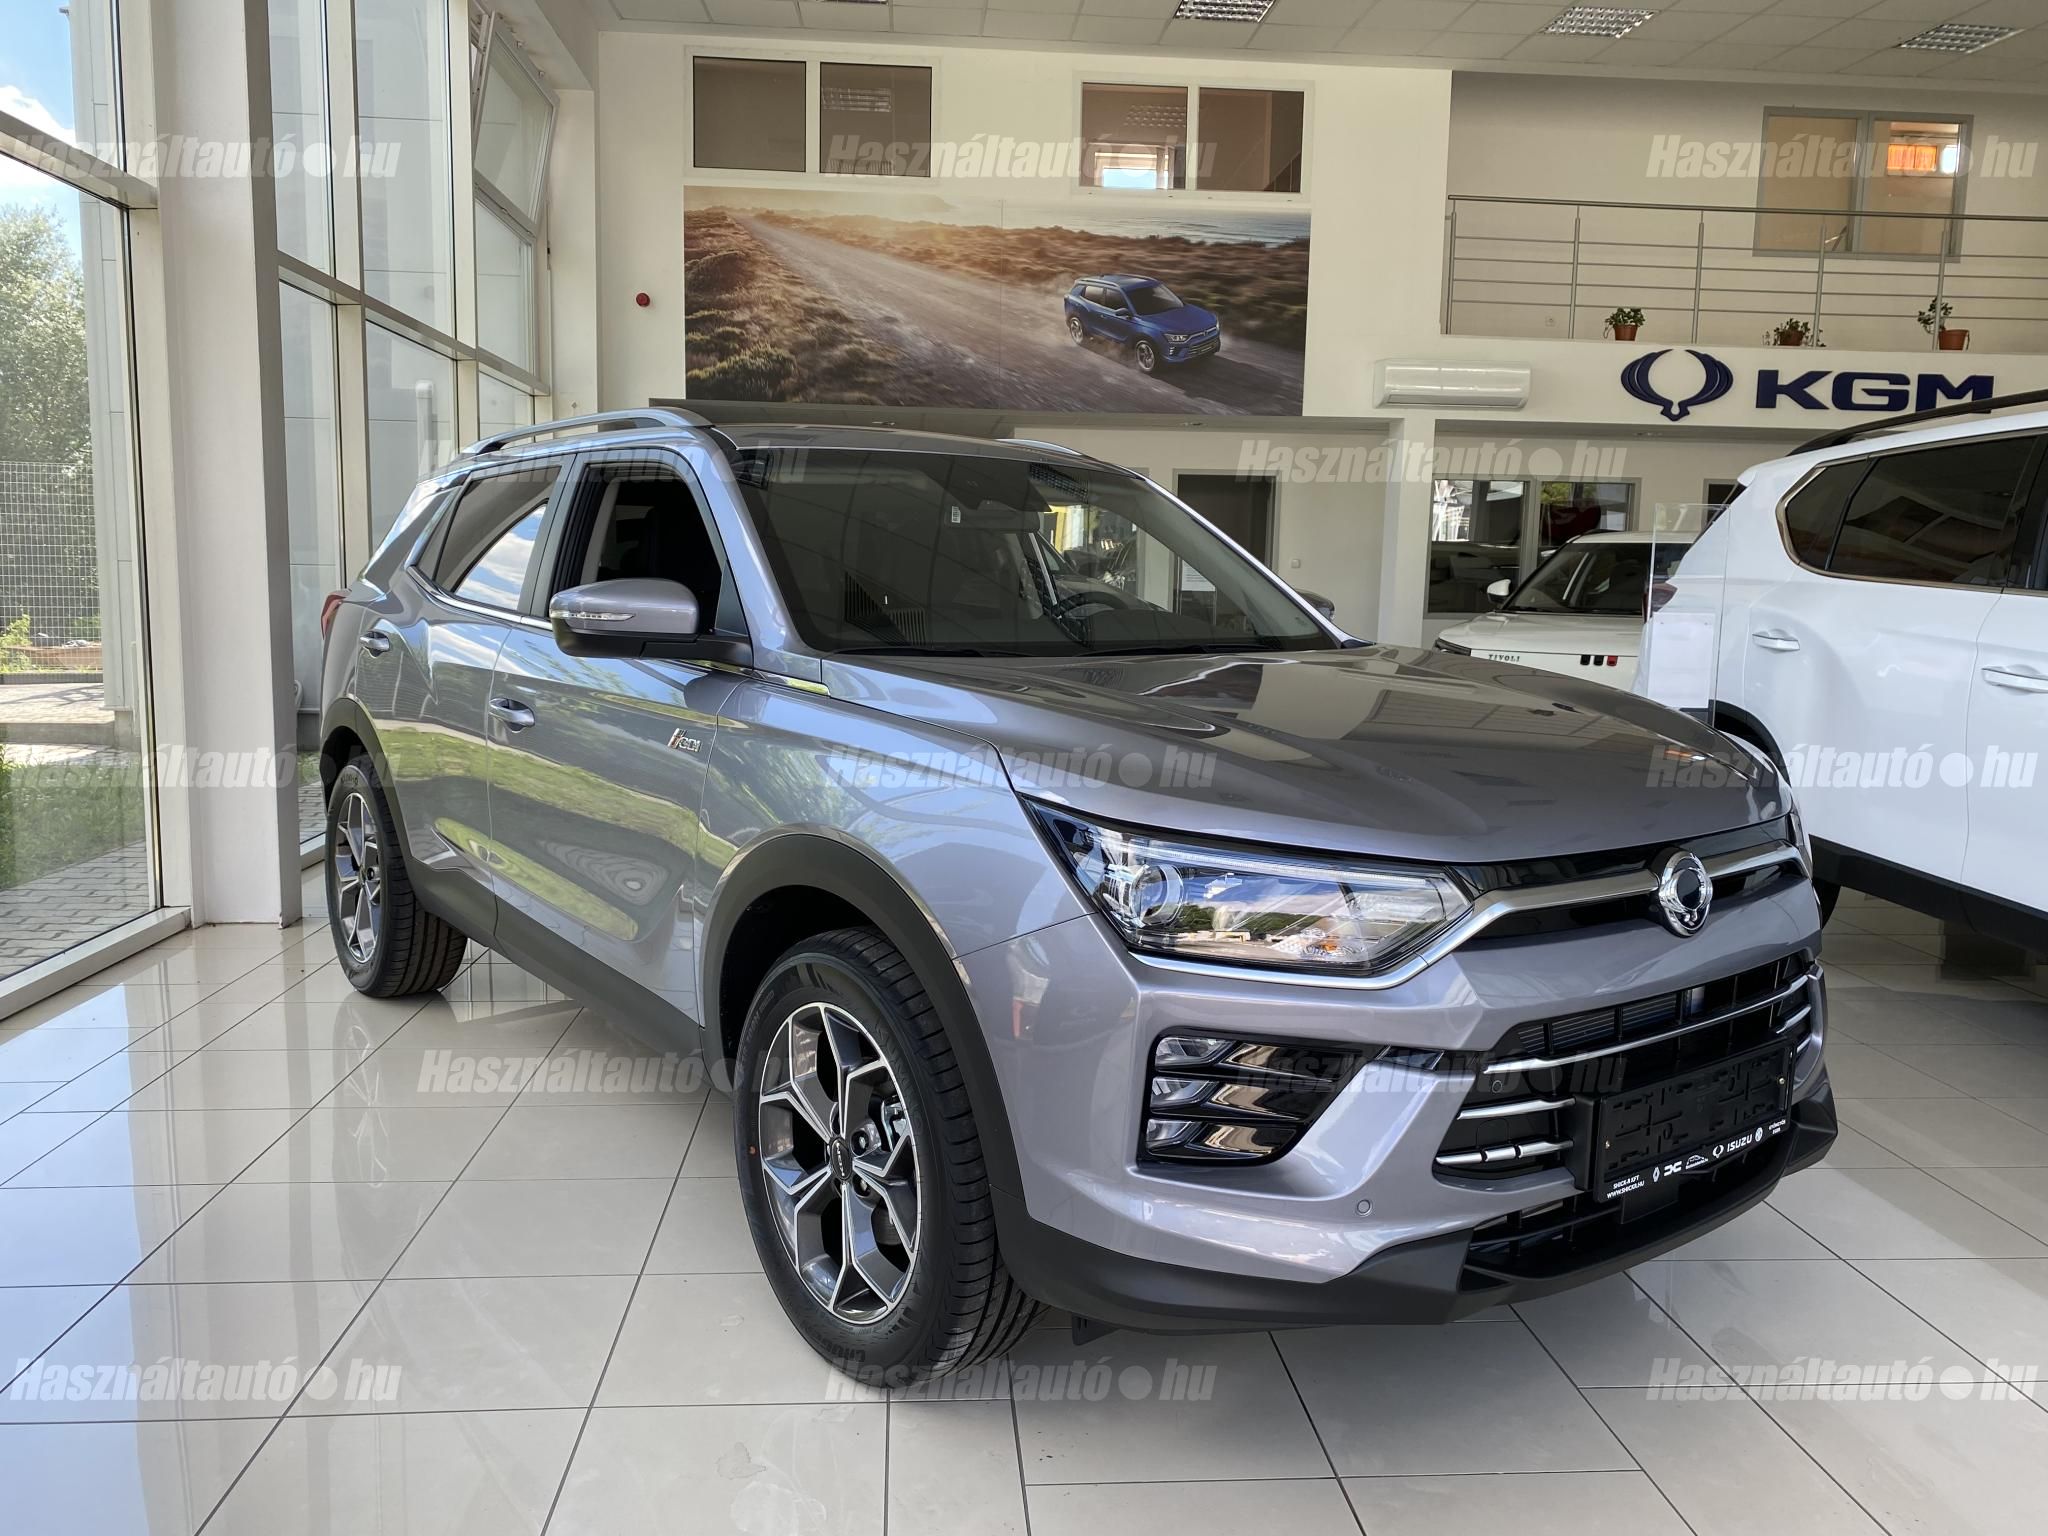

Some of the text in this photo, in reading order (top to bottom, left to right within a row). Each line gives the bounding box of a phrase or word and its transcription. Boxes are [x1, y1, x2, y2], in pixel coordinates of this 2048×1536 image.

[1756, 369, 1994, 413] KGM
[1488, 654, 1520, 662] TIVOLI
[1726, 1133, 1753, 1152] ISUZU
